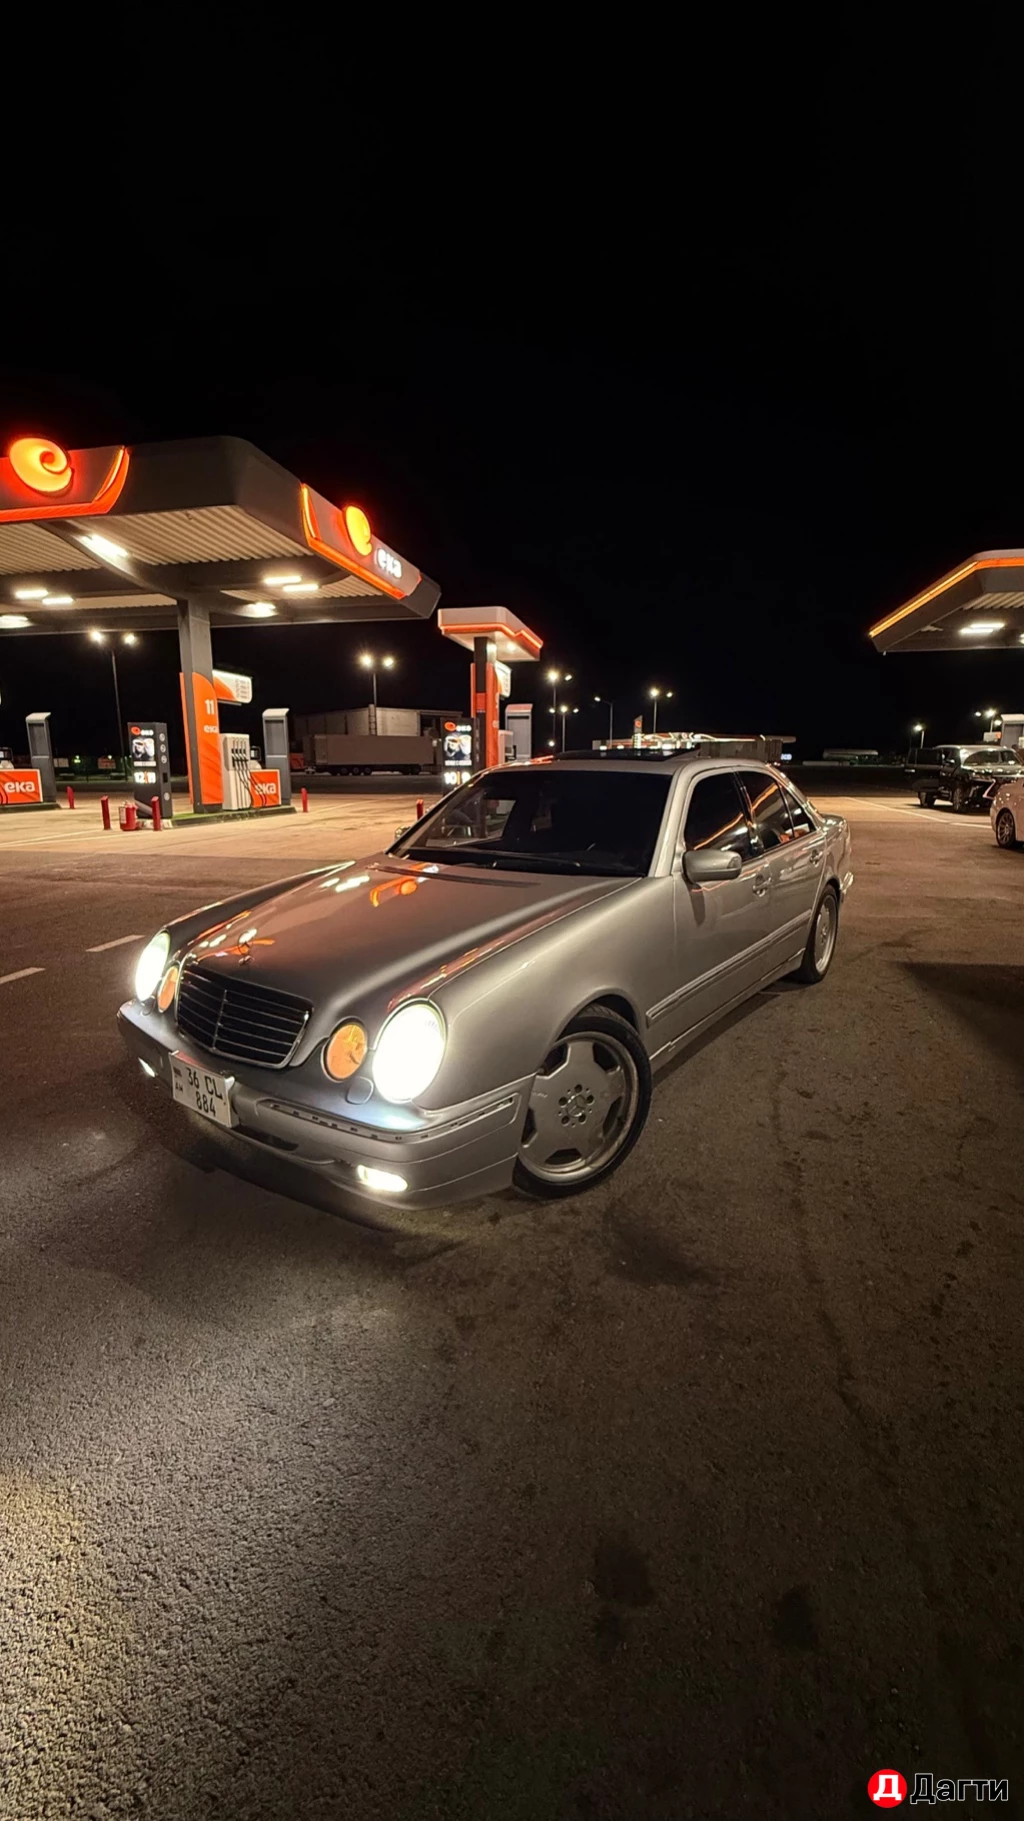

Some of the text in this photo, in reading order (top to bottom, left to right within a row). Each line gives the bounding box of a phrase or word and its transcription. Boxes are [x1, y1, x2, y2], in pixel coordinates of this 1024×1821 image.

[4, 781, 36, 793] eka
[185, 1066, 223, 1100] 36 CL
[195, 1091, 216, 1116] 884
